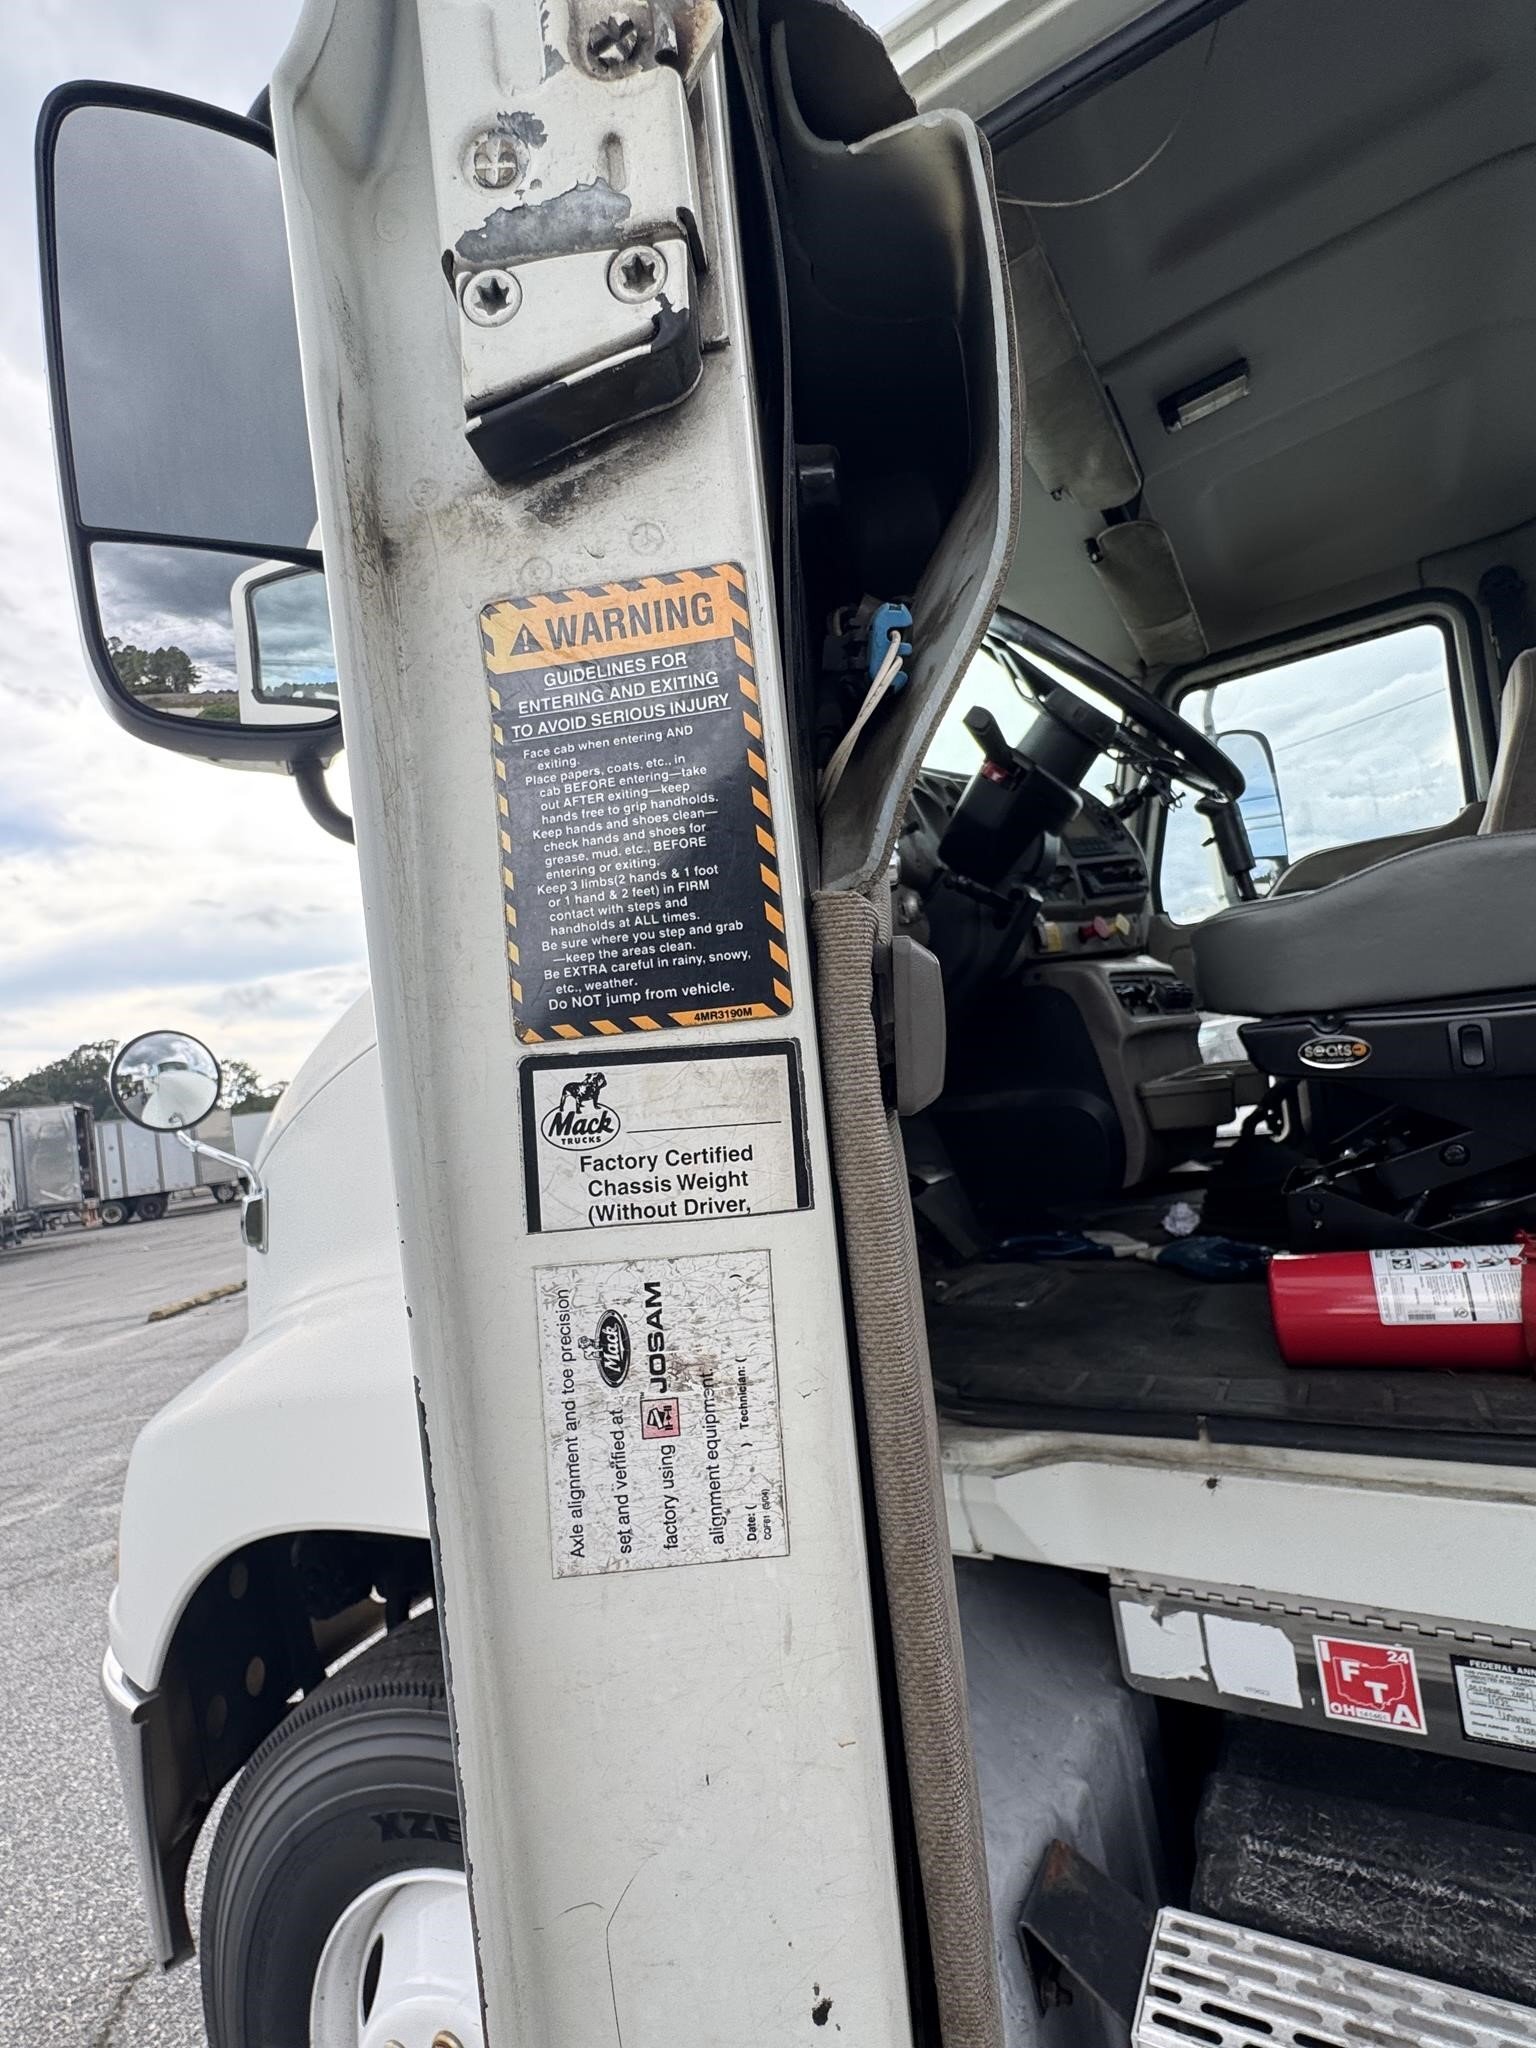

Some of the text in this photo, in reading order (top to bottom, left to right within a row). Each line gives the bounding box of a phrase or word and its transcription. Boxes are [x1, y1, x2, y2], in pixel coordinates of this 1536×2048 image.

[545, 592, 714, 650] WARNING
[544, 651, 687, 687] GUIDELINES FOR
[518, 671, 718, 715] ENTERING AND EXITING
[512, 692, 730, 739] TO AVOID SERIOUS INJURY
[524, 725, 693, 759] Face cab when entering AND
[526, 774, 557, 785] Place
[675, 755, 686, 766] in
[538, 757, 580, 770] exiting.
[540, 785, 560, 797] cab
[565, 777, 616, 793] BEFORE
[541, 799, 560, 811] out
[564, 792, 604, 807] AFTER
[542, 792, 718, 824] hands free to grip handholds.
[533, 828, 562, 839] Keep
[566, 821, 603, 834] hands
[607, 816, 628, 829] and
[632, 813, 669, 825] shoes
[544, 822, 706, 852] check hands and shoes for
[654, 836, 707, 851] BEFORE
[538, 883, 567, 895] Keep
[570, 880, 577, 890] 3
[630, 870, 667, 883] hands
[672, 867, 679, 878] &
[685, 866, 689, 877] 1
[694, 864, 718, 876] foot
[546, 858, 660, 879] entering or exiting.
[549, 879, 709, 908] or 1 hand & 2 feet) in FIRM
[550, 895, 687, 921] contact with steps and
[542, 919, 743, 951] Be sure where you step and grab
[551, 911, 700, 936] handholds at ALL times.
[599, 948, 618, 959] the
[622, 945, 655, 957] areas
[660, 941, 696, 952] clean.
[544, 969, 560, 980] Be
[564, 963, 607, 977] EXTRA
[611, 958, 653, 972] careful
[658, 957, 669, 967] in
[673, 955, 705, 966] rainy,
[549, 980, 734, 1010] Do NOT jump from vehicle.
[585, 977, 638, 991] weather.
[694, 1006, 753, 1022] 4MR3190M
[1304, 1043, 1352, 1058] seats
[548, 1111, 615, 1138] Mack
[561, 1135, 602, 1146] TRUCKS
[580, 1144, 753, 1173] Factory Certified
[588, 1170, 749, 1197] Chassis Weight
[588, 1197, 751, 1228] (Without Driver,
[602, 1323, 621, 1372] Mack
[645, 1281, 668, 1394] JOSAM
[737, 1366, 749, 1430] Technician:
[557, 1289, 585, 1558] Axle alignment and toe precision
[702, 1368, 727, 1545] alignment equipment.
[609, 1409, 632, 1553] set and verified at
[660, 1444, 679, 1550] factory using
[747, 1513, 758, 1541] Date:
[1340, 1660, 1360, 1682] F
[1386, 1651, 1409, 1664] 24
[1469, 1660, 1514, 1673] FEDERAL
[1363, 1681, 1388, 1704] T
[1330, 1702, 1355, 1716] OH
[1393, 1703, 1419, 1727] A
